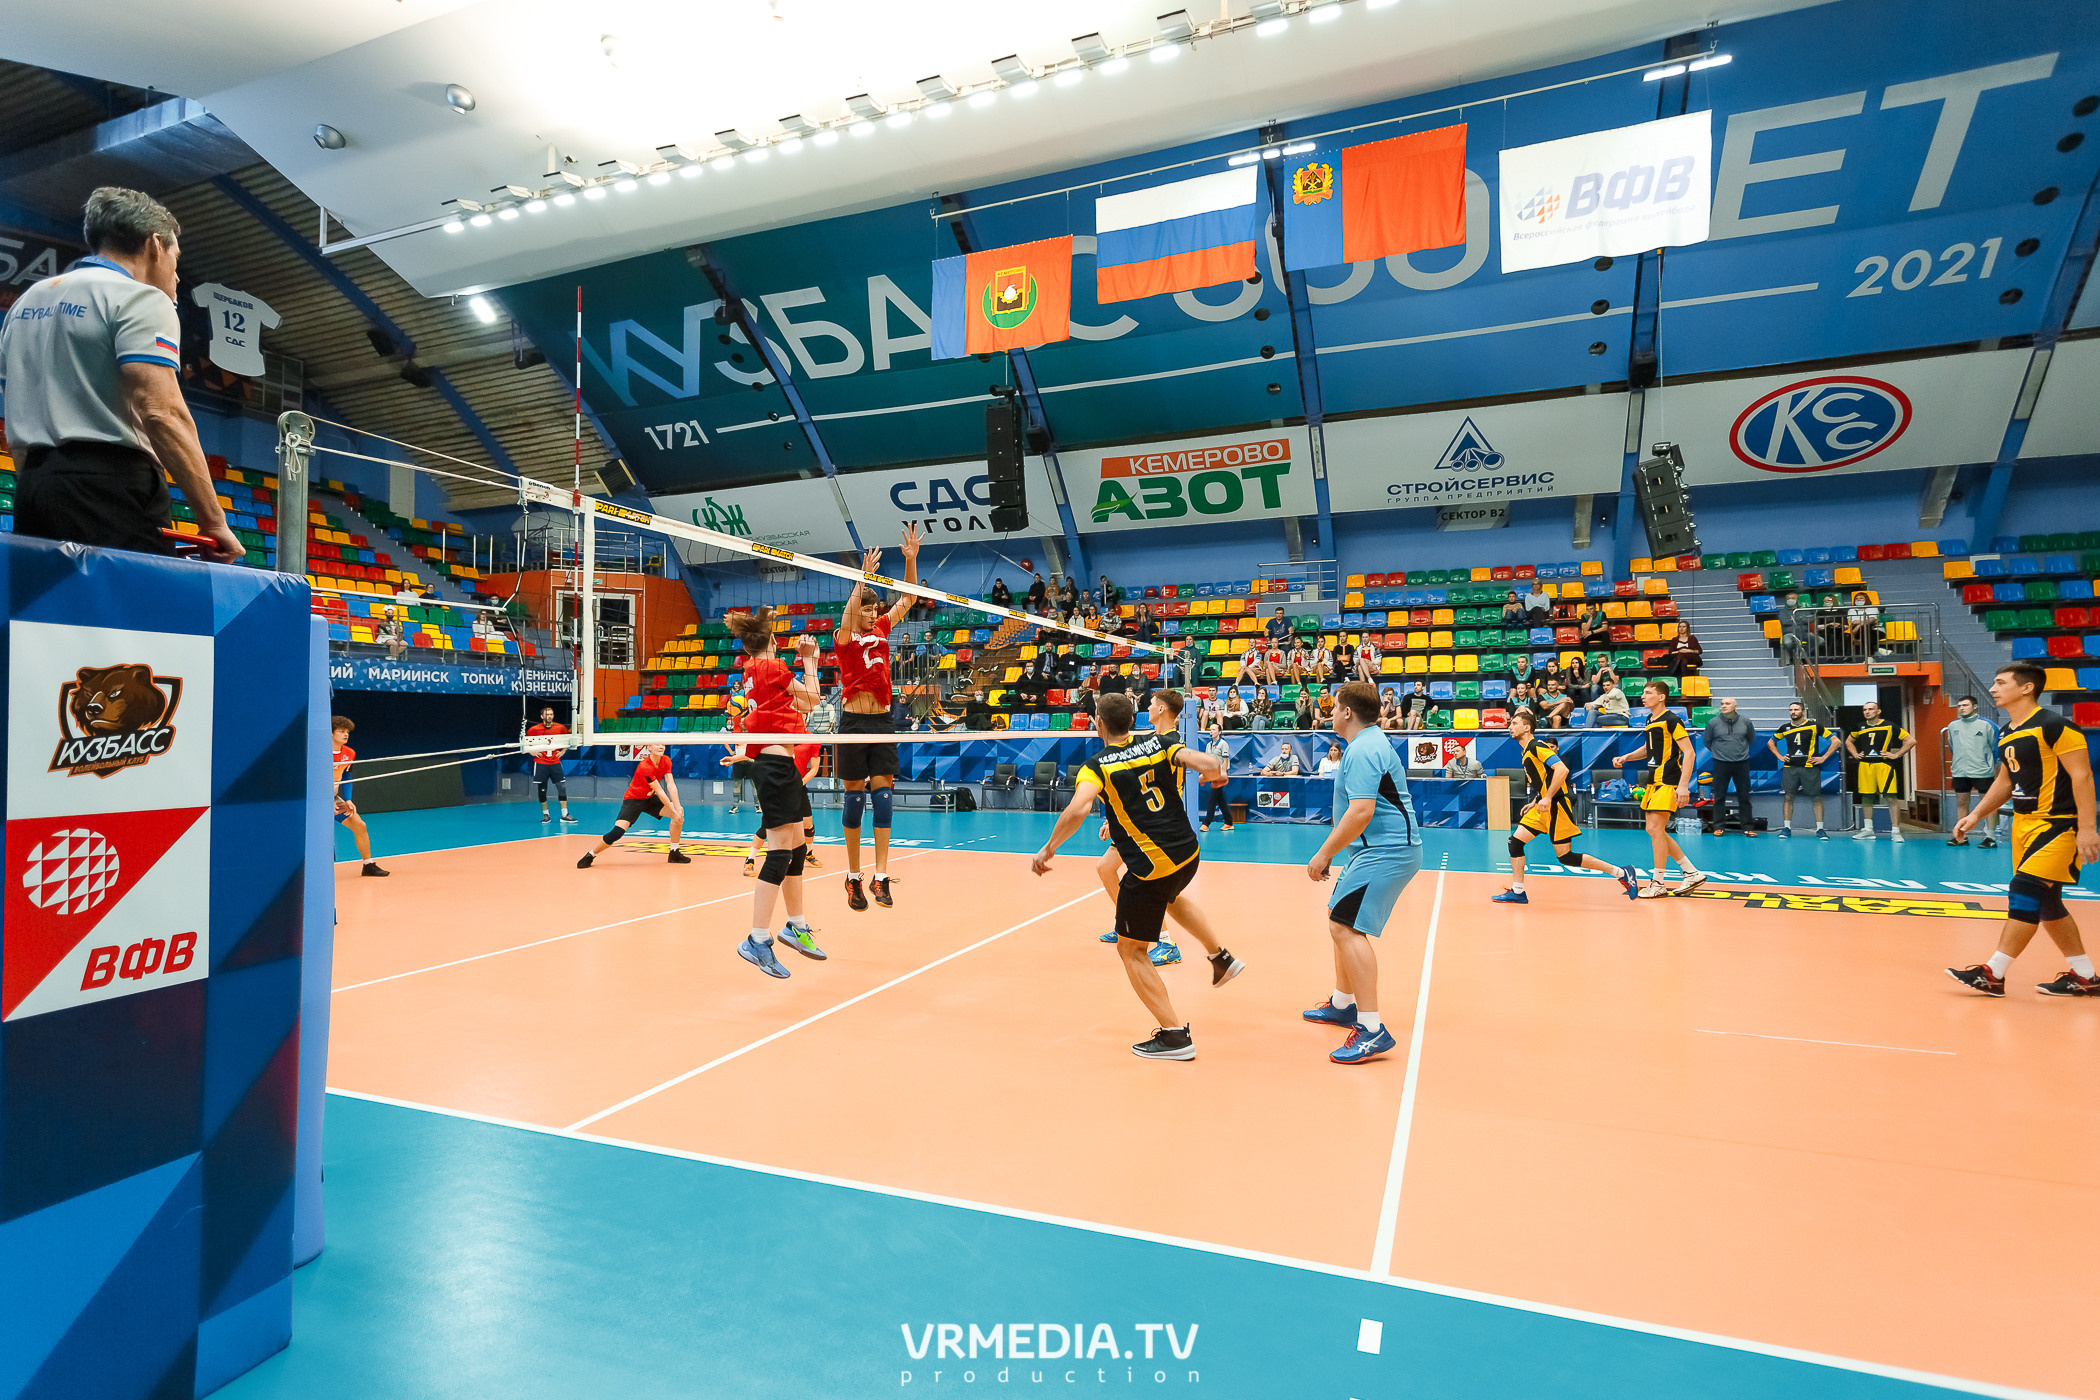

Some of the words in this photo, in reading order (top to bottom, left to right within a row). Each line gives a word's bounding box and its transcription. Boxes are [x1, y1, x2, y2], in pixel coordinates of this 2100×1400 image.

[1565, 156, 1695, 219] ВФВ
[569, 235, 1139, 406] КУЗБА
[1707, 52, 2060, 242] ЕТ
[1513, 223, 1583, 241] Всероссийская
[1585, 215, 1640, 232] федерация
[1641, 204, 1696, 222] волейбола
[1845, 237, 2002, 299] 2021
[59, 301, 87, 318] TIME
[222, 309, 246, 334] 12
[644, 420, 709, 451] 1721
[1765, 385, 1878, 465] КСС
[1128, 441, 1284, 475] КЕМЕРОВО
[889, 474, 991, 514] СДС
[1090, 462, 1291, 523] АЗОТ
[1386, 471, 1555, 496] СТРОЙСЕРВИС
[1387, 495, 1439, 504] ГРУППА
[1447, 485, 1554, 500] ПРЕДПРИЯТИЙ
[595, 501, 618, 516] PARI
[1441, 509, 1487, 521] СЕКТОР
[1490, 508, 1505, 518] В2
[901, 513, 995, 534] УГОЛ
[368, 667, 449, 683] МАРИИНСК
[460, 672, 504, 685] ТОПКИ
[511, 680, 573, 693] КУЗНЕЦКИ
[57, 728, 170, 766] КУЗБАСС
[1793, 732, 1802, 746] 4
[1868, 732, 1876, 746] 7
[73, 757, 127, 773] ВОЛЕЙБОЛЬНЫЙ
[125, 755, 146, 765] КЛУБ
[2004, 745, 2020, 773] 8
[1138, 768, 1165, 812] 5
[80, 931, 198, 992] ВФВ
